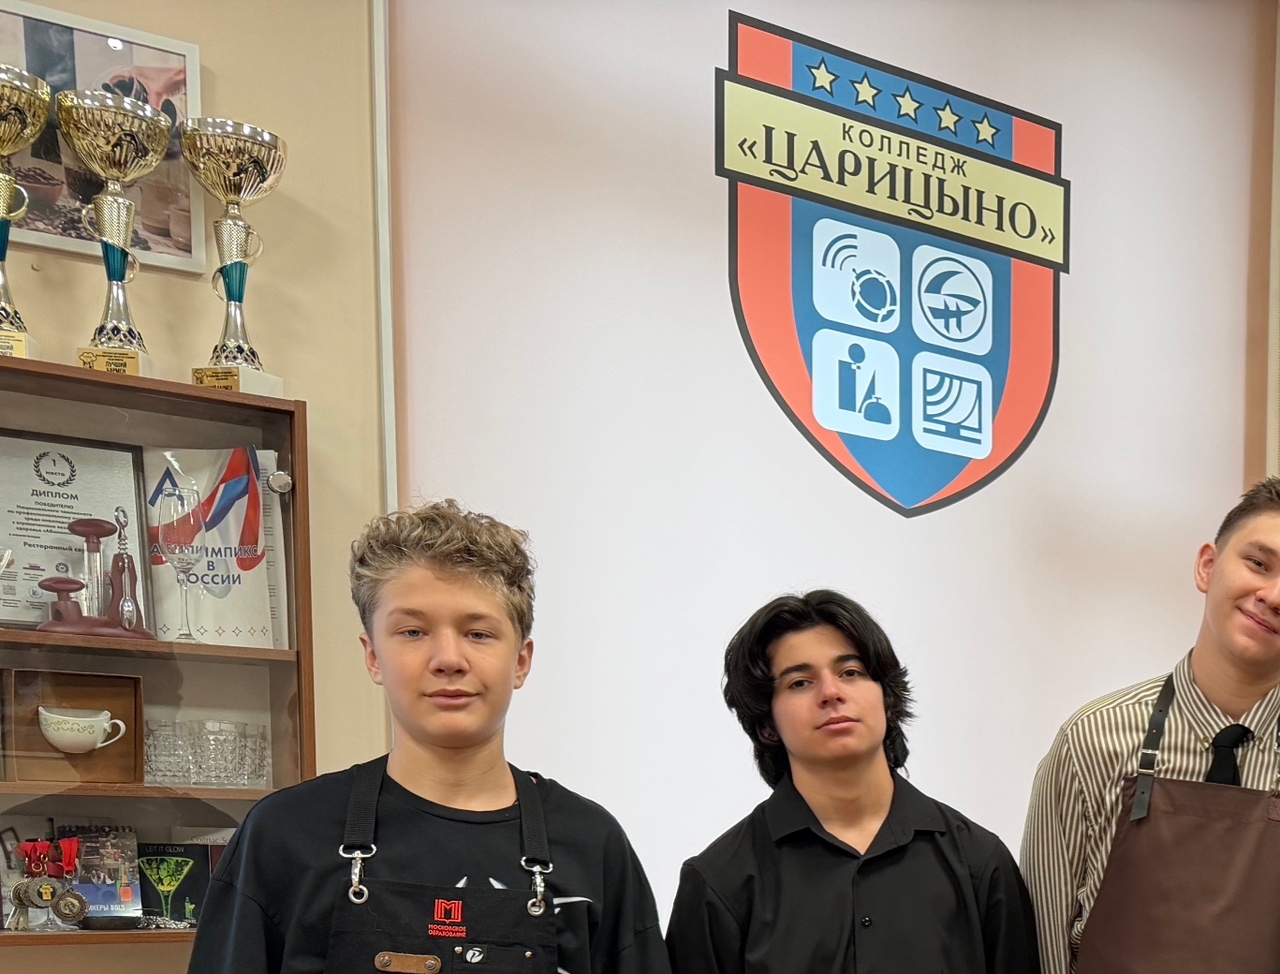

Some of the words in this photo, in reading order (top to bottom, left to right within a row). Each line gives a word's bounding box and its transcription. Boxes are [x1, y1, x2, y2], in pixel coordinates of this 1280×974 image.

[842, 122, 968, 178] КОЛЛЕДЖ
[737, 123, 1056, 245] «ЦАРИЦЫНО»
[30, 489, 79, 501] ДИПЛОМ
[23, 541, 73, 553] Ресторанный
[206, 560, 216, 571] В
[177, 573, 242, 586] ОССИИ
[145, 845, 157, 853] LET
